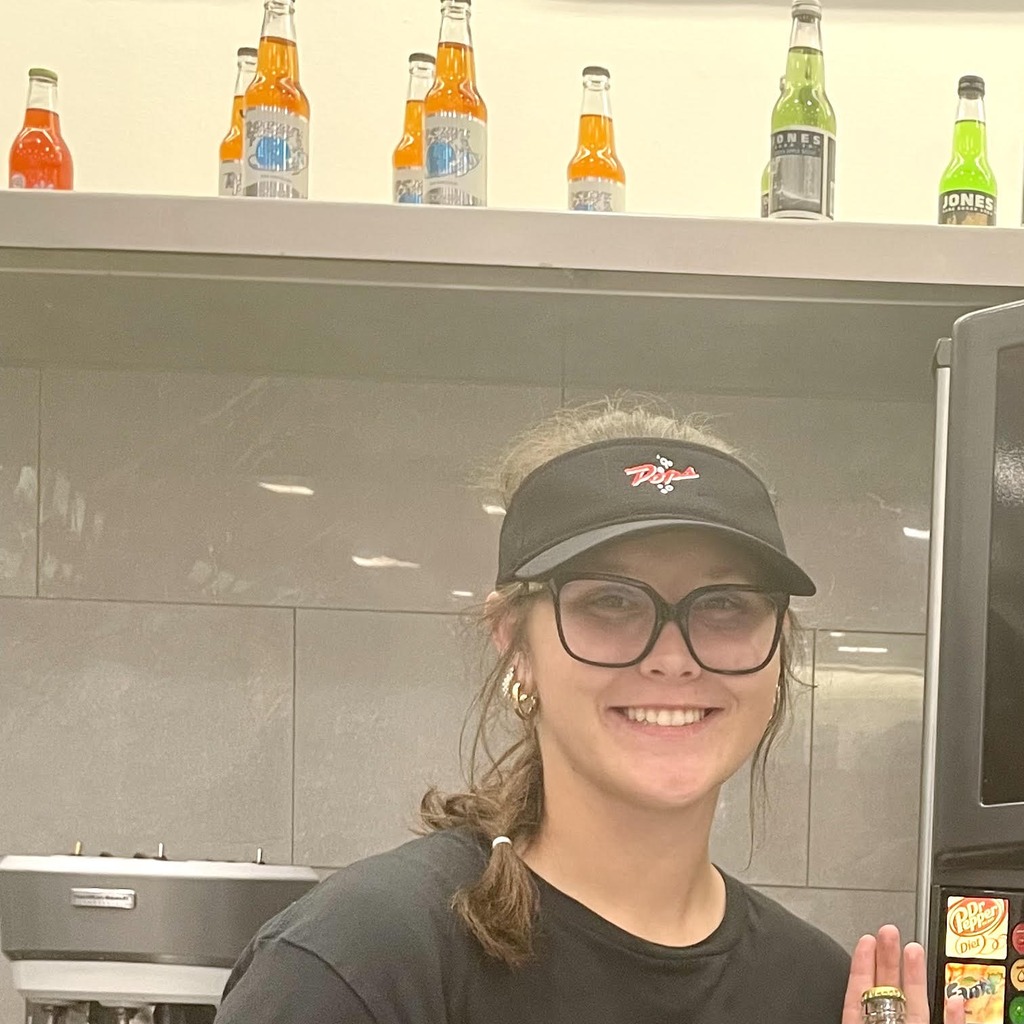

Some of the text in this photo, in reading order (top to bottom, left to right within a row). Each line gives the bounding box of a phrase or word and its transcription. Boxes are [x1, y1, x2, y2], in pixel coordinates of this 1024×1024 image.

[773, 132, 821, 145] ONES
[942, 192, 994, 211] JONES
[624, 463, 700, 487] Pops
[967, 901, 986, 918] Dr
[953, 906, 998, 934] Pepper
[960, 938, 980, 954] Diet
